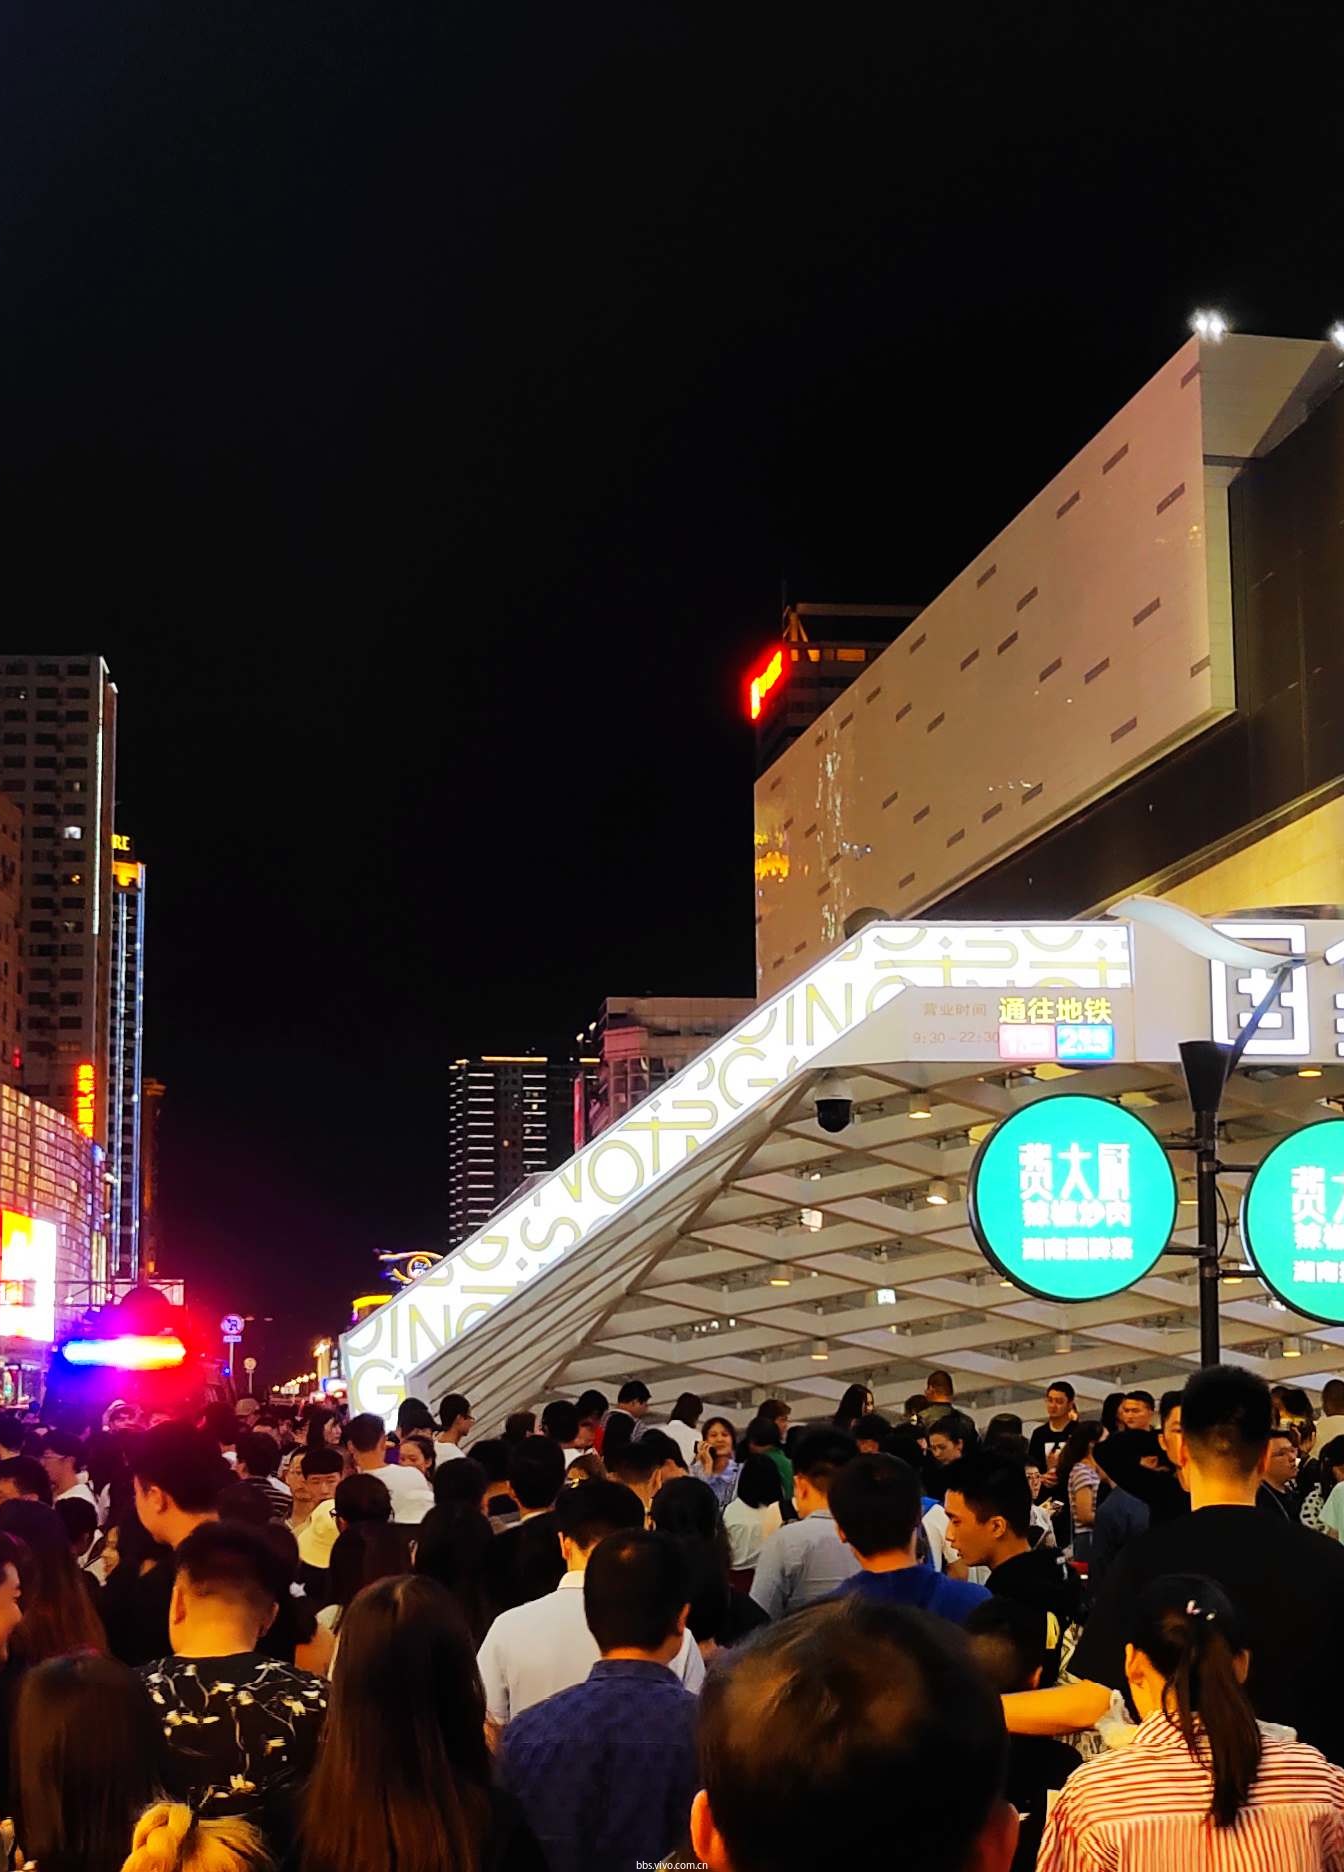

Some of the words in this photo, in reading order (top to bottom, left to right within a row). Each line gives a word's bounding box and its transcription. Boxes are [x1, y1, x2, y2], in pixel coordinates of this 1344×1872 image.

[922, 1002, 987, 1017] 营业时间
[998, 997, 1113, 1024] 通往地铁
[1018, 1142, 1131, 1201] 费大厨
